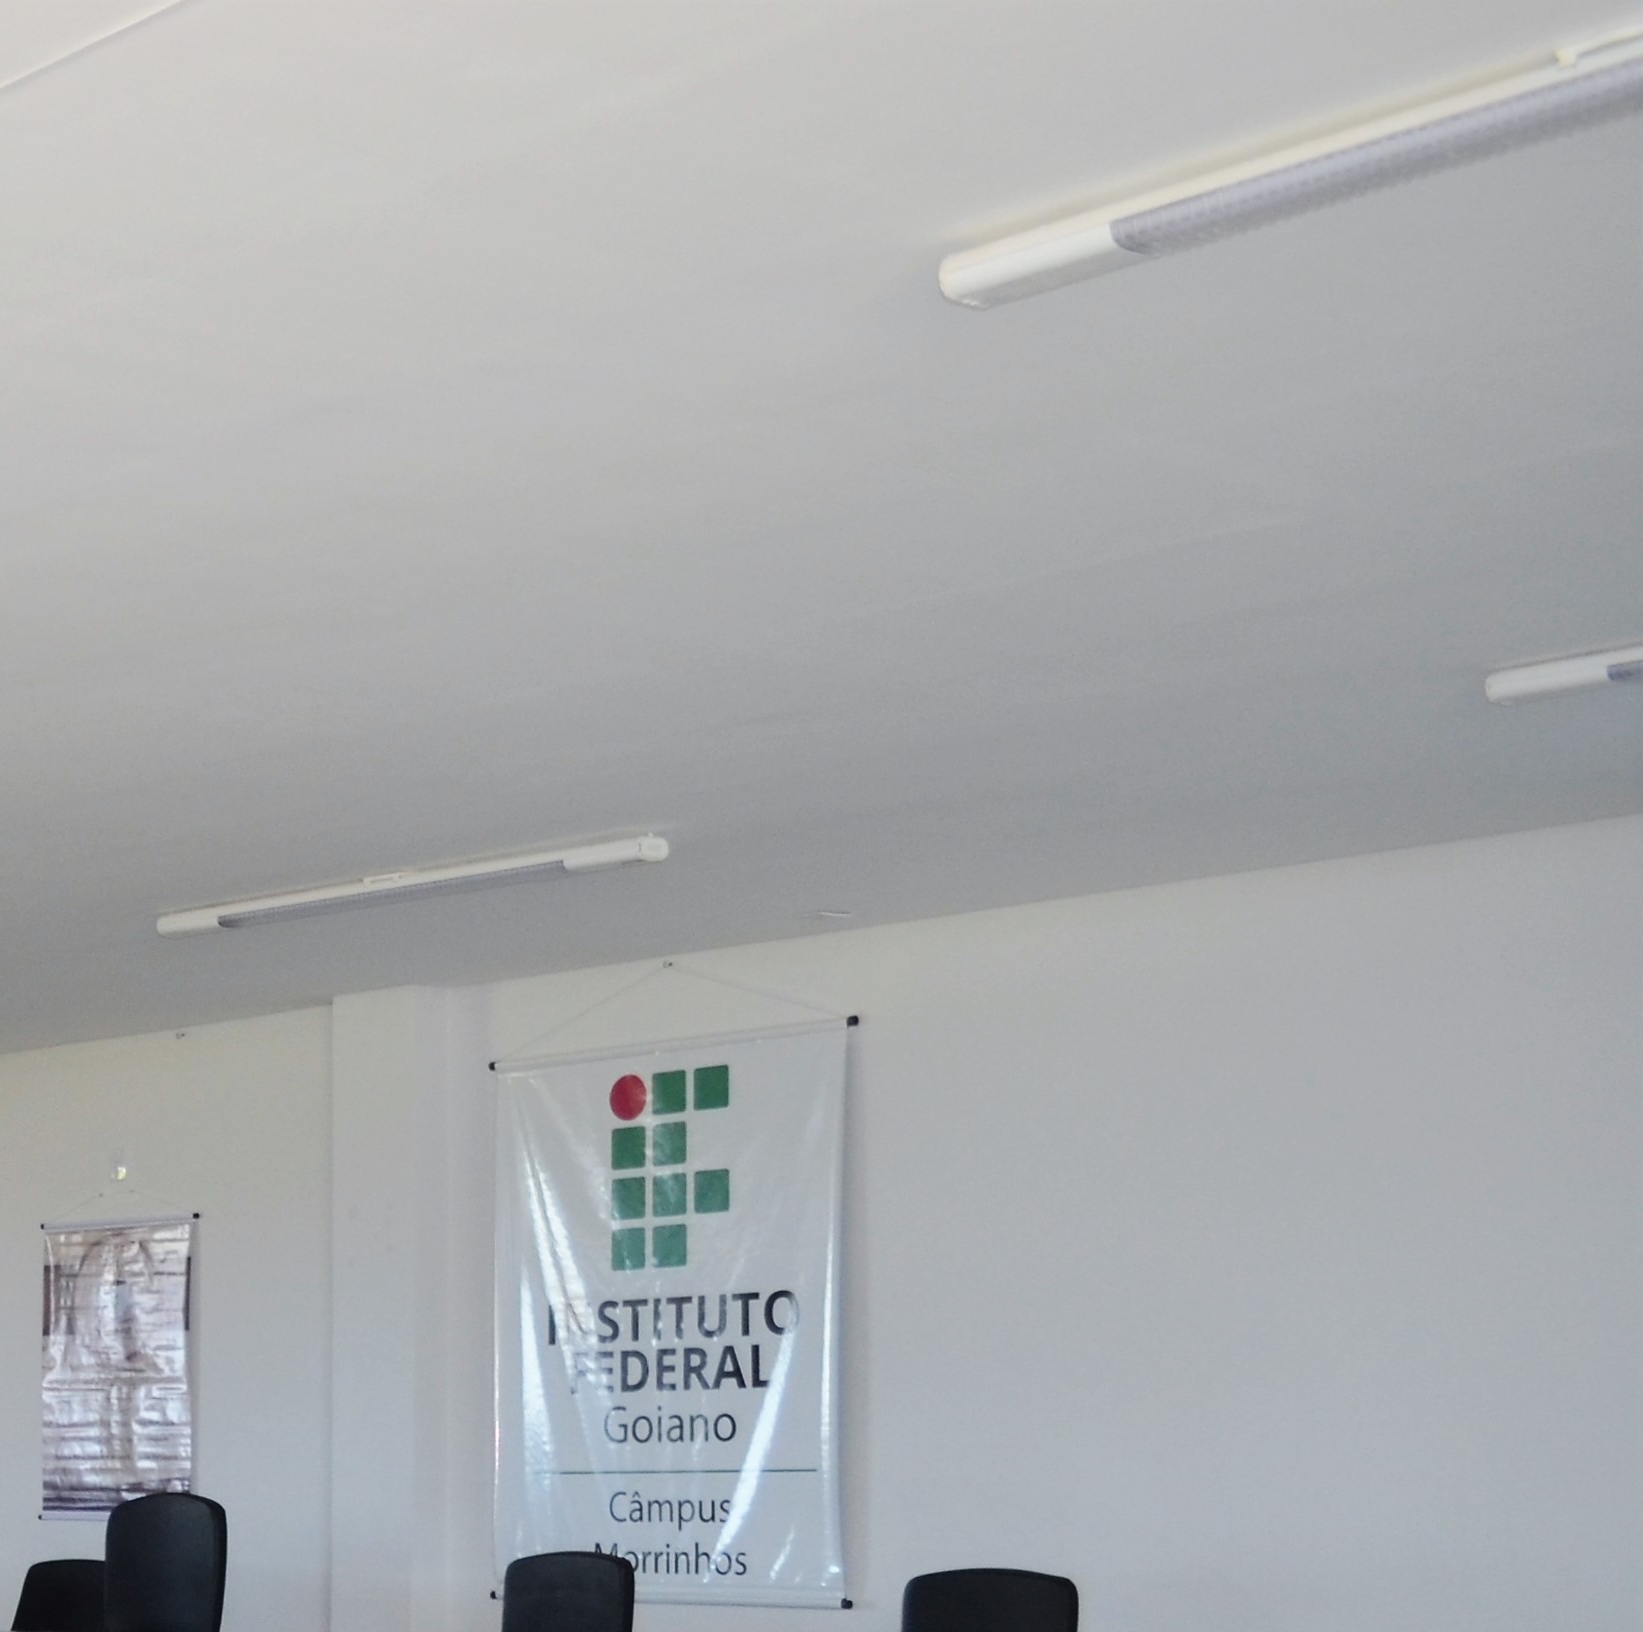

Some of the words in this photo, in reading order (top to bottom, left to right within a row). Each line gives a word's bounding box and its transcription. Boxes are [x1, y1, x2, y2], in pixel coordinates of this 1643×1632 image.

[570, 1345, 772, 1395] FEDERAL
[604, 1405, 737, 1443] Goiano
[610, 1491, 733, 1531] Câmpus
